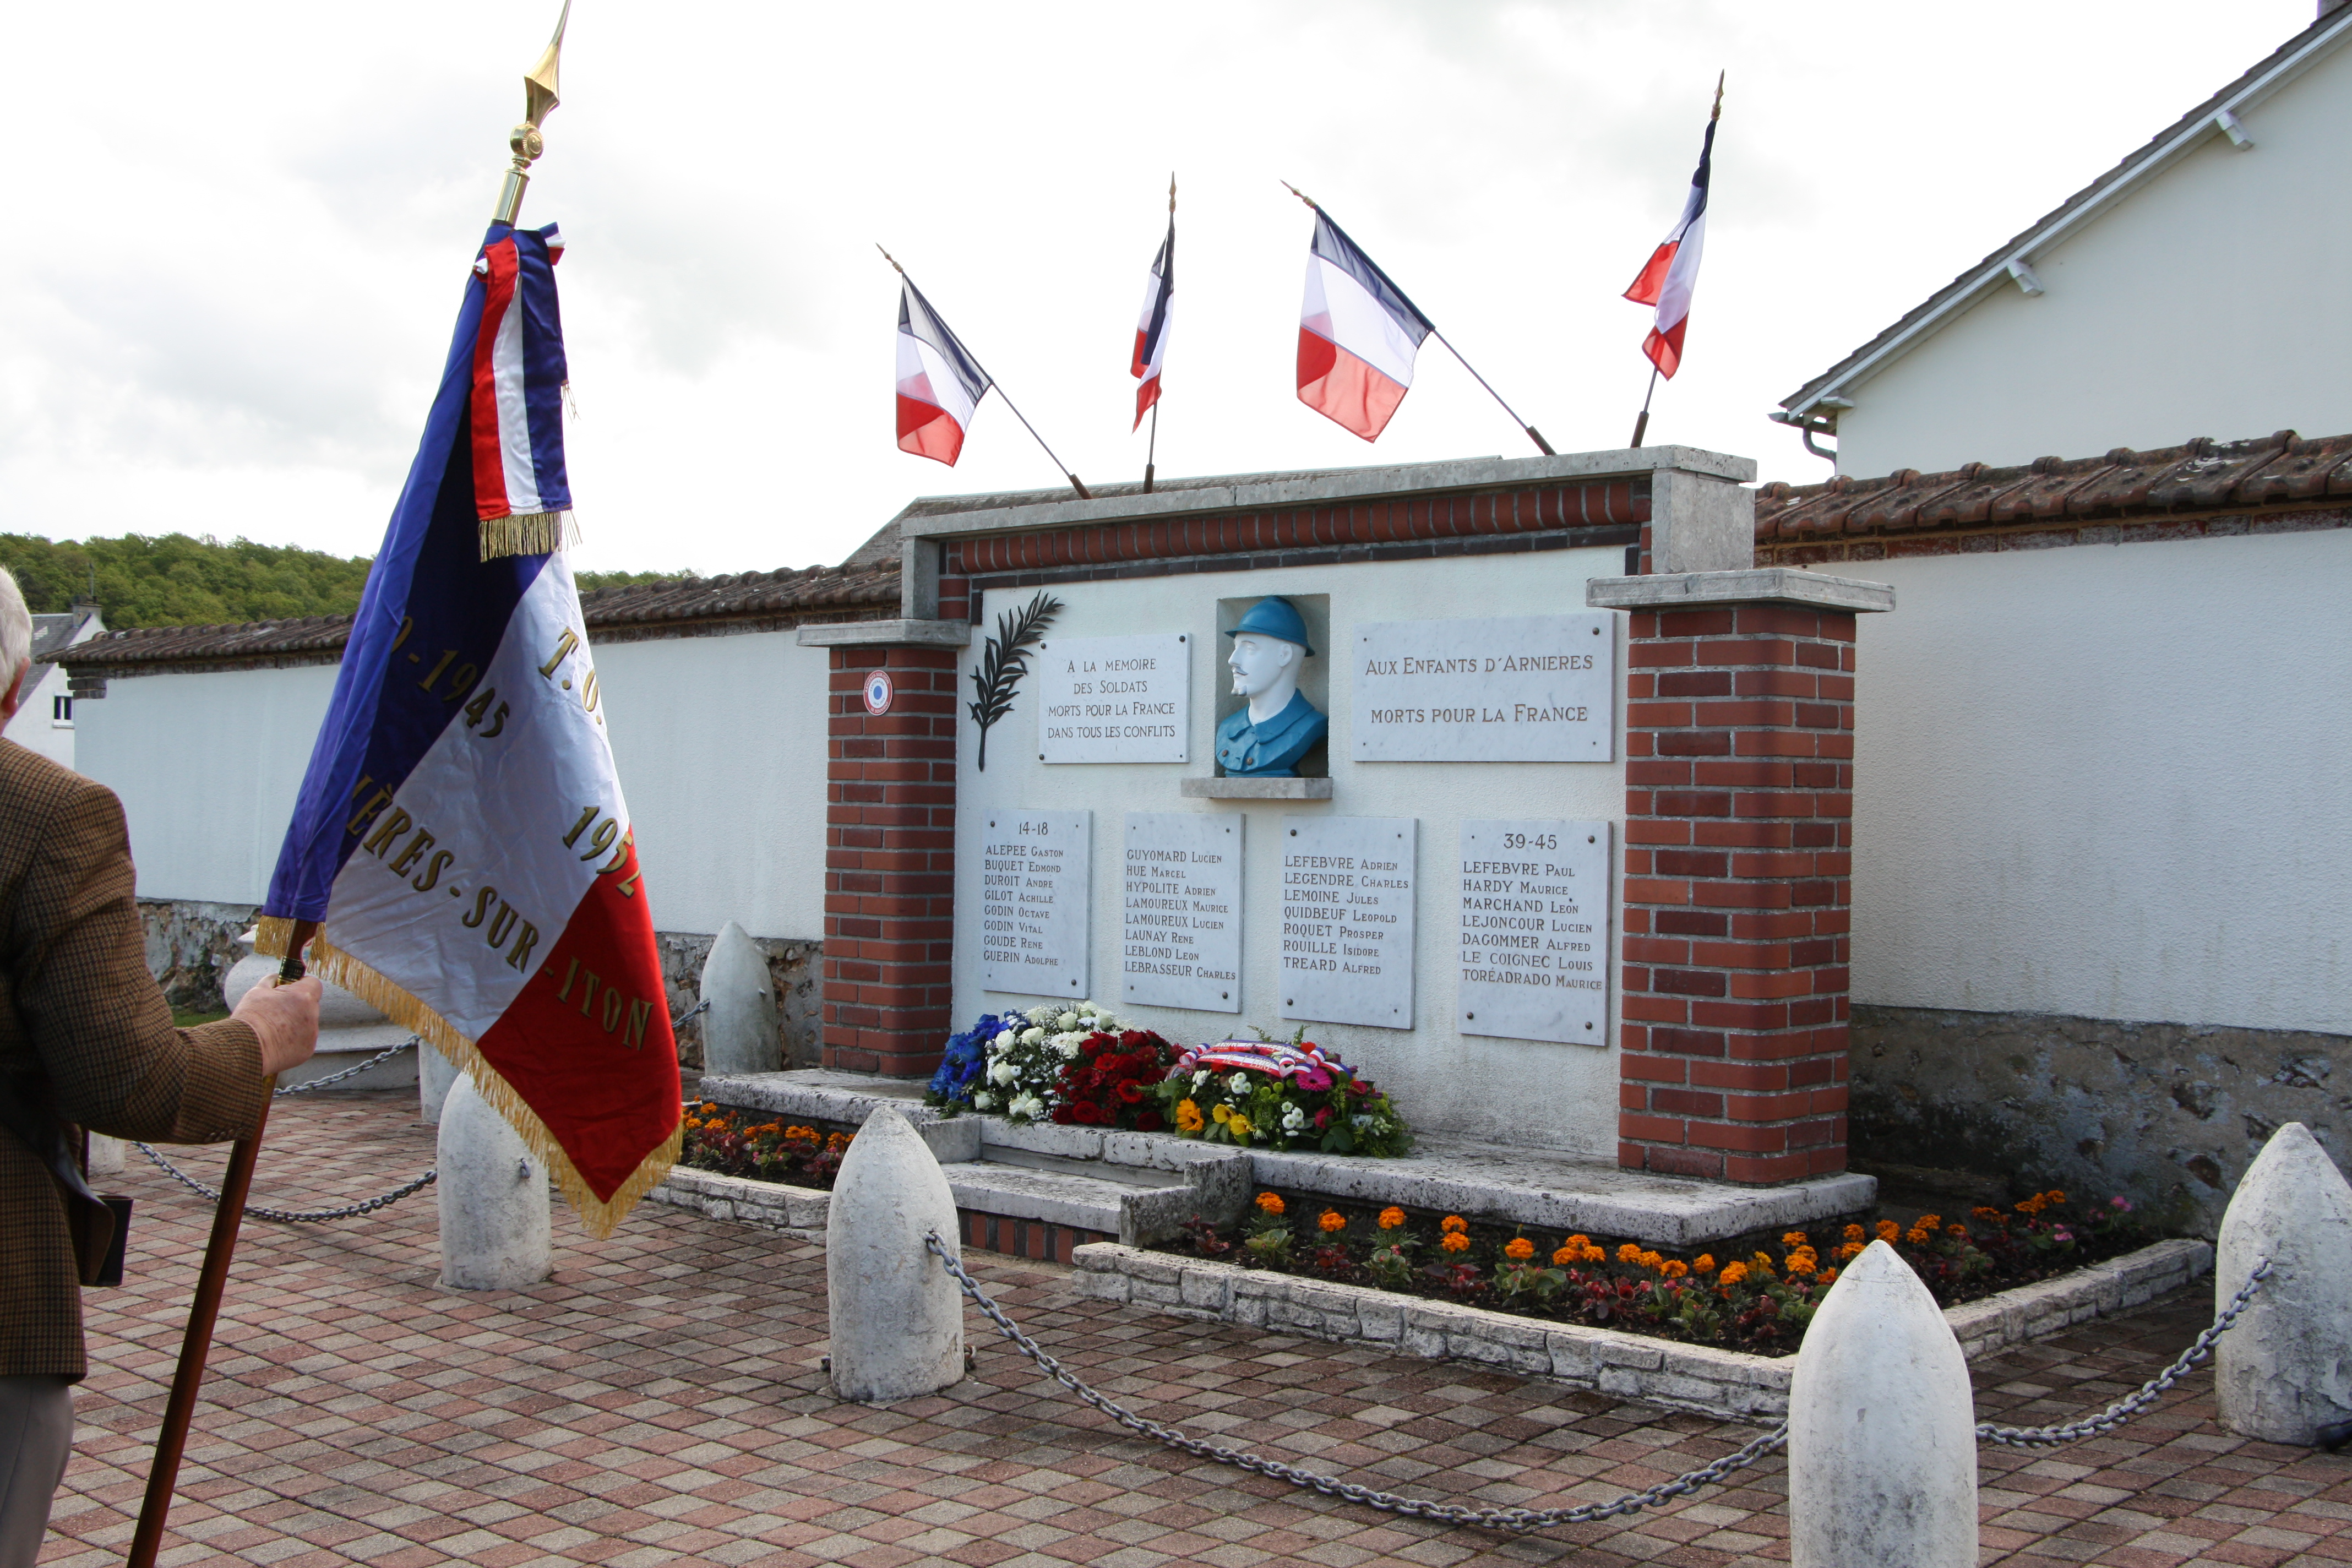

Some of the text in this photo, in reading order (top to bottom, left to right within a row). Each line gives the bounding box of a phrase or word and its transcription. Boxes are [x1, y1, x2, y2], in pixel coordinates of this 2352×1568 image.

[1067, 659, 1156, 673] A LA MEMOIRE
[1365, 655, 1593, 676] AUX ENFANTS D'ARNIERES
[1074, 680, 1148, 694] DES SOLDATS
[1048, 702, 1175, 716] MORTS POUR LA FRANCE
[1371, 704, 1588, 723] MORTS POUR LA FRANCE
[1048, 726, 1175, 738] DANS TOUS LES CONFLITS
[1019, 821, 1048, 835] 14-18
[1504, 833, 1558, 850] 39-45
[985, 845, 1064, 857] ALEPEE GASTON
[1126, 849, 1222, 863] GUYOMARD LUCIEN
[985, 859, 1061, 873] BUQUET EDMOND
[1285, 856, 1398, 871] LEFEBVRE ADRIEN
[1463, 861, 1576, 878] LEFEBVRE PAUL
[1126, 865, 1186, 879] HUE MARCEL
[984, 875, 1053, 889] DUROIT ANDRE
[1126, 881, 1216, 896] HYPOLITE ADRIEN
[1284, 872, 1409, 889] LEGENDRE CHARLES
[1463, 879, 1569, 895] HARDY MAURICE
[985, 890, 1054, 903] GILOT ACHILLE
[1284, 889, 1379, 905] LEMOINE JULES
[984, 905, 1050, 919] GODIN OCTAVE
[1126, 897, 1229, 913] LAMOUREUX MAURICE
[1463, 897, 1579, 914] MARCHAND LEON
[1125, 913, 1224, 929] LAMOUREUX LUCIEN
[1284, 906, 1397, 923] QUIDBEUF LEOPOLD
[984, 921, 1043, 934] GODIN VITAL
[1283, 923, 1384, 940] ROQUET PROSPER
[1462, 916, 1592, 933] LEJONCOUR LUCIEN
[984, 935, 1043, 949] GOUDE RENE
[1125, 929, 1194, 944] LAUNAY RENE
[1462, 933, 1591, 952] DAGOMMER ALFRED
[1125, 945, 1200, 961] LEBLOND LEON
[1283, 940, 1379, 957] ROUILLE ISIDORE
[983, 950, 1059, 966] GUERIN ADOLPHE
[1283, 957, 1381, 975] TREARD ALFRED
[1462, 951, 1593, 971] LE COIGNEC LOUIS
[1125, 961, 1236, 980] LEBRASSEUR CHARLES
[1555, 975, 1602, 990] MAURICE
